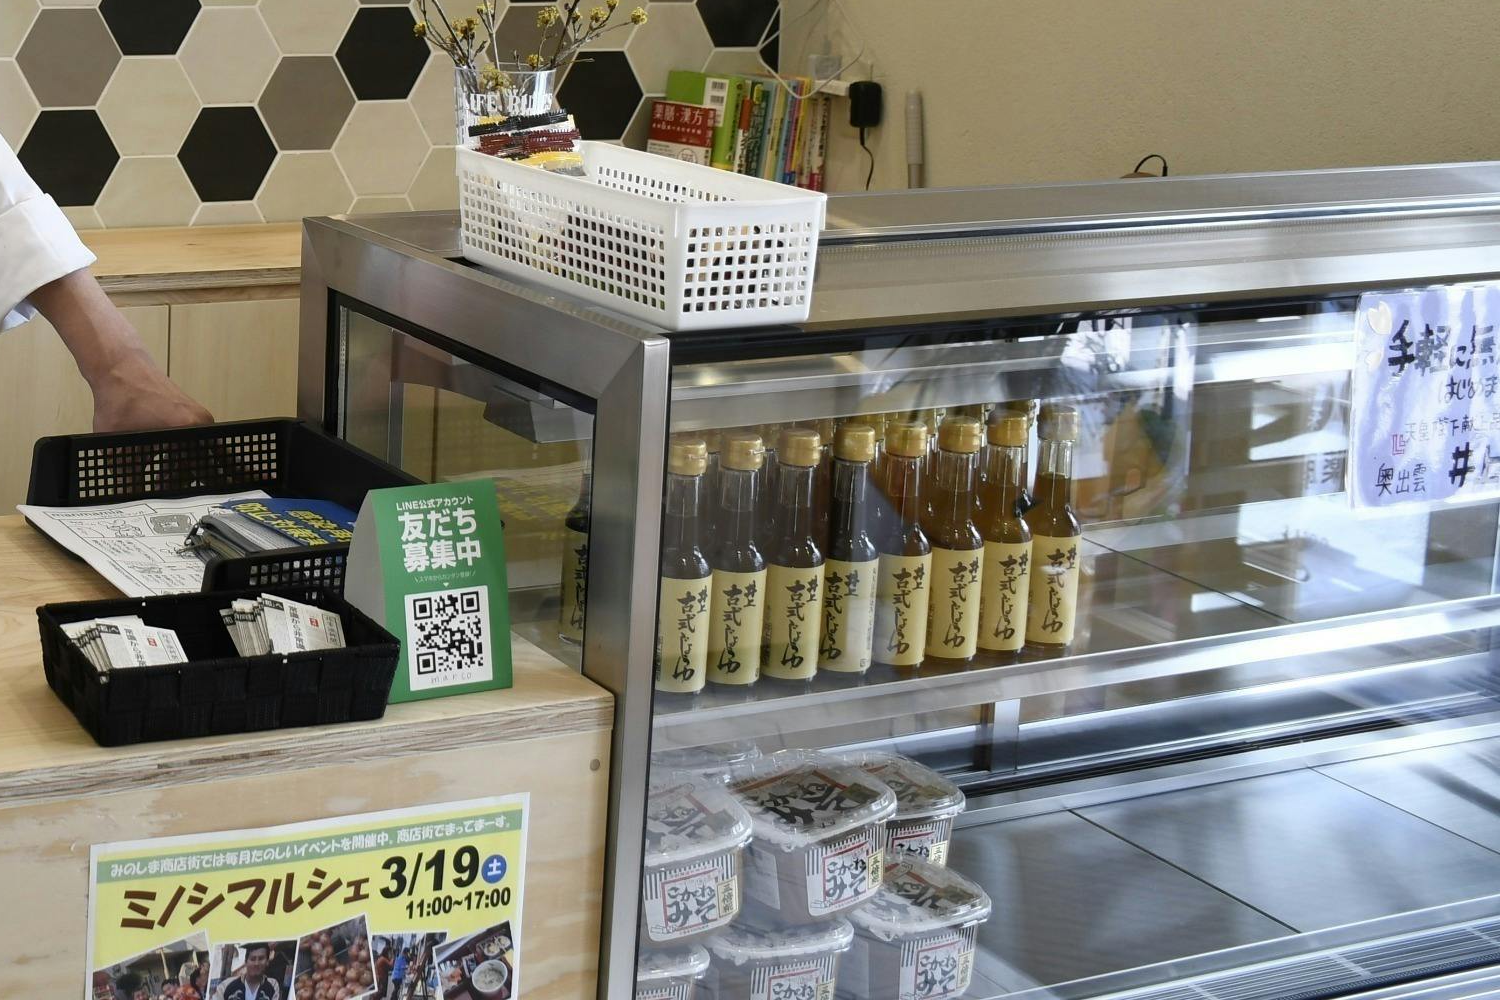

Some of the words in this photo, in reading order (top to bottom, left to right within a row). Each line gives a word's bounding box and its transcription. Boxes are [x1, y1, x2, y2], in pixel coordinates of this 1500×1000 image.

[1375, 463, 1427, 497] 奥出雲
[396, 495, 474, 512] LINE公式アカウント
[398, 507, 478, 542] 友だち
[402, 537, 482, 574] 募集中
[120, 867, 370, 930] ミノシマルシェ
[379, 844, 480, 899] 3/19
[486, 858, 502, 877] 土
